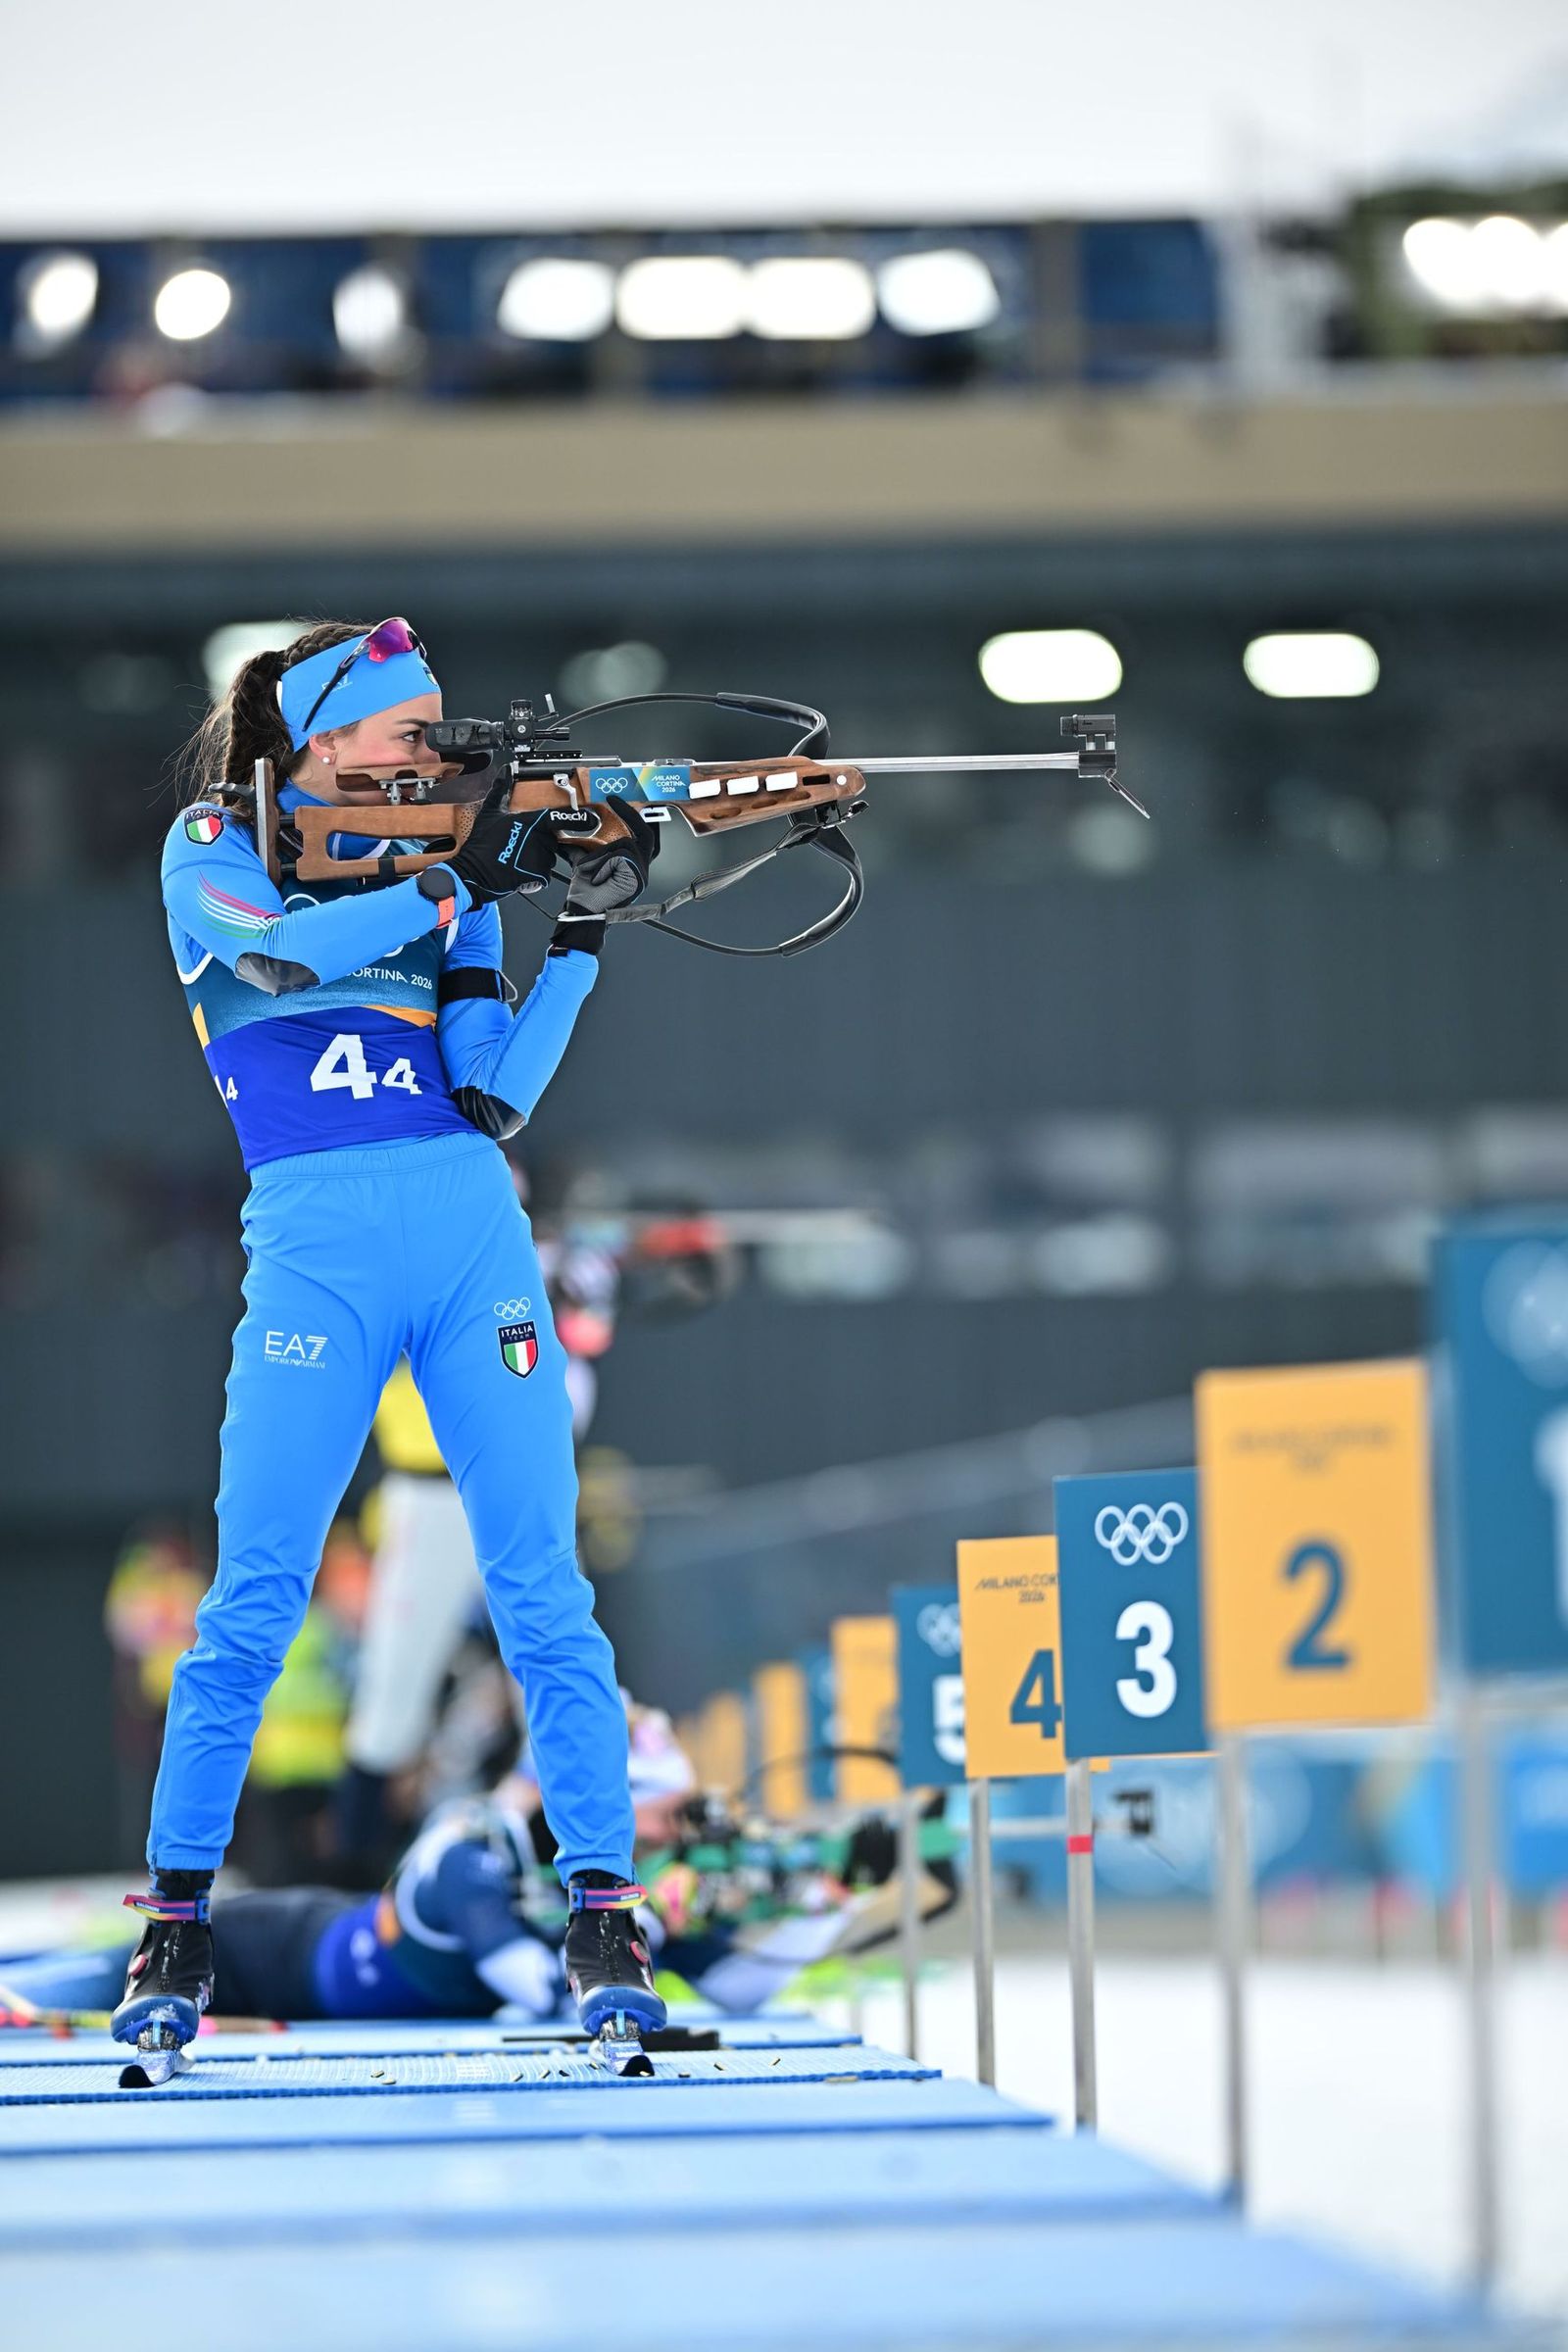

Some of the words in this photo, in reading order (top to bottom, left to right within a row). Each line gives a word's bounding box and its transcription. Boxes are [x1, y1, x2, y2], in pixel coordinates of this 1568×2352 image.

[498, 821, 523, 864] Roeckl
[346, 967, 408, 984] ORTINA
[411, 973, 433, 990] 2026
[226, 1076, 239, 1101] 4
[310, 1033, 377, 1100] 4
[381, 1057, 422, 1095] 4
[265, 1330, 328, 1360] EA7
[501, 1325, 534, 1338] ITALIA
[1282, 1537, 1352, 1673] 2
[1115, 1600, 1178, 1718] 3
[933, 1675, 966, 1765] 5
[1009, 1648, 1063, 1740] 4
